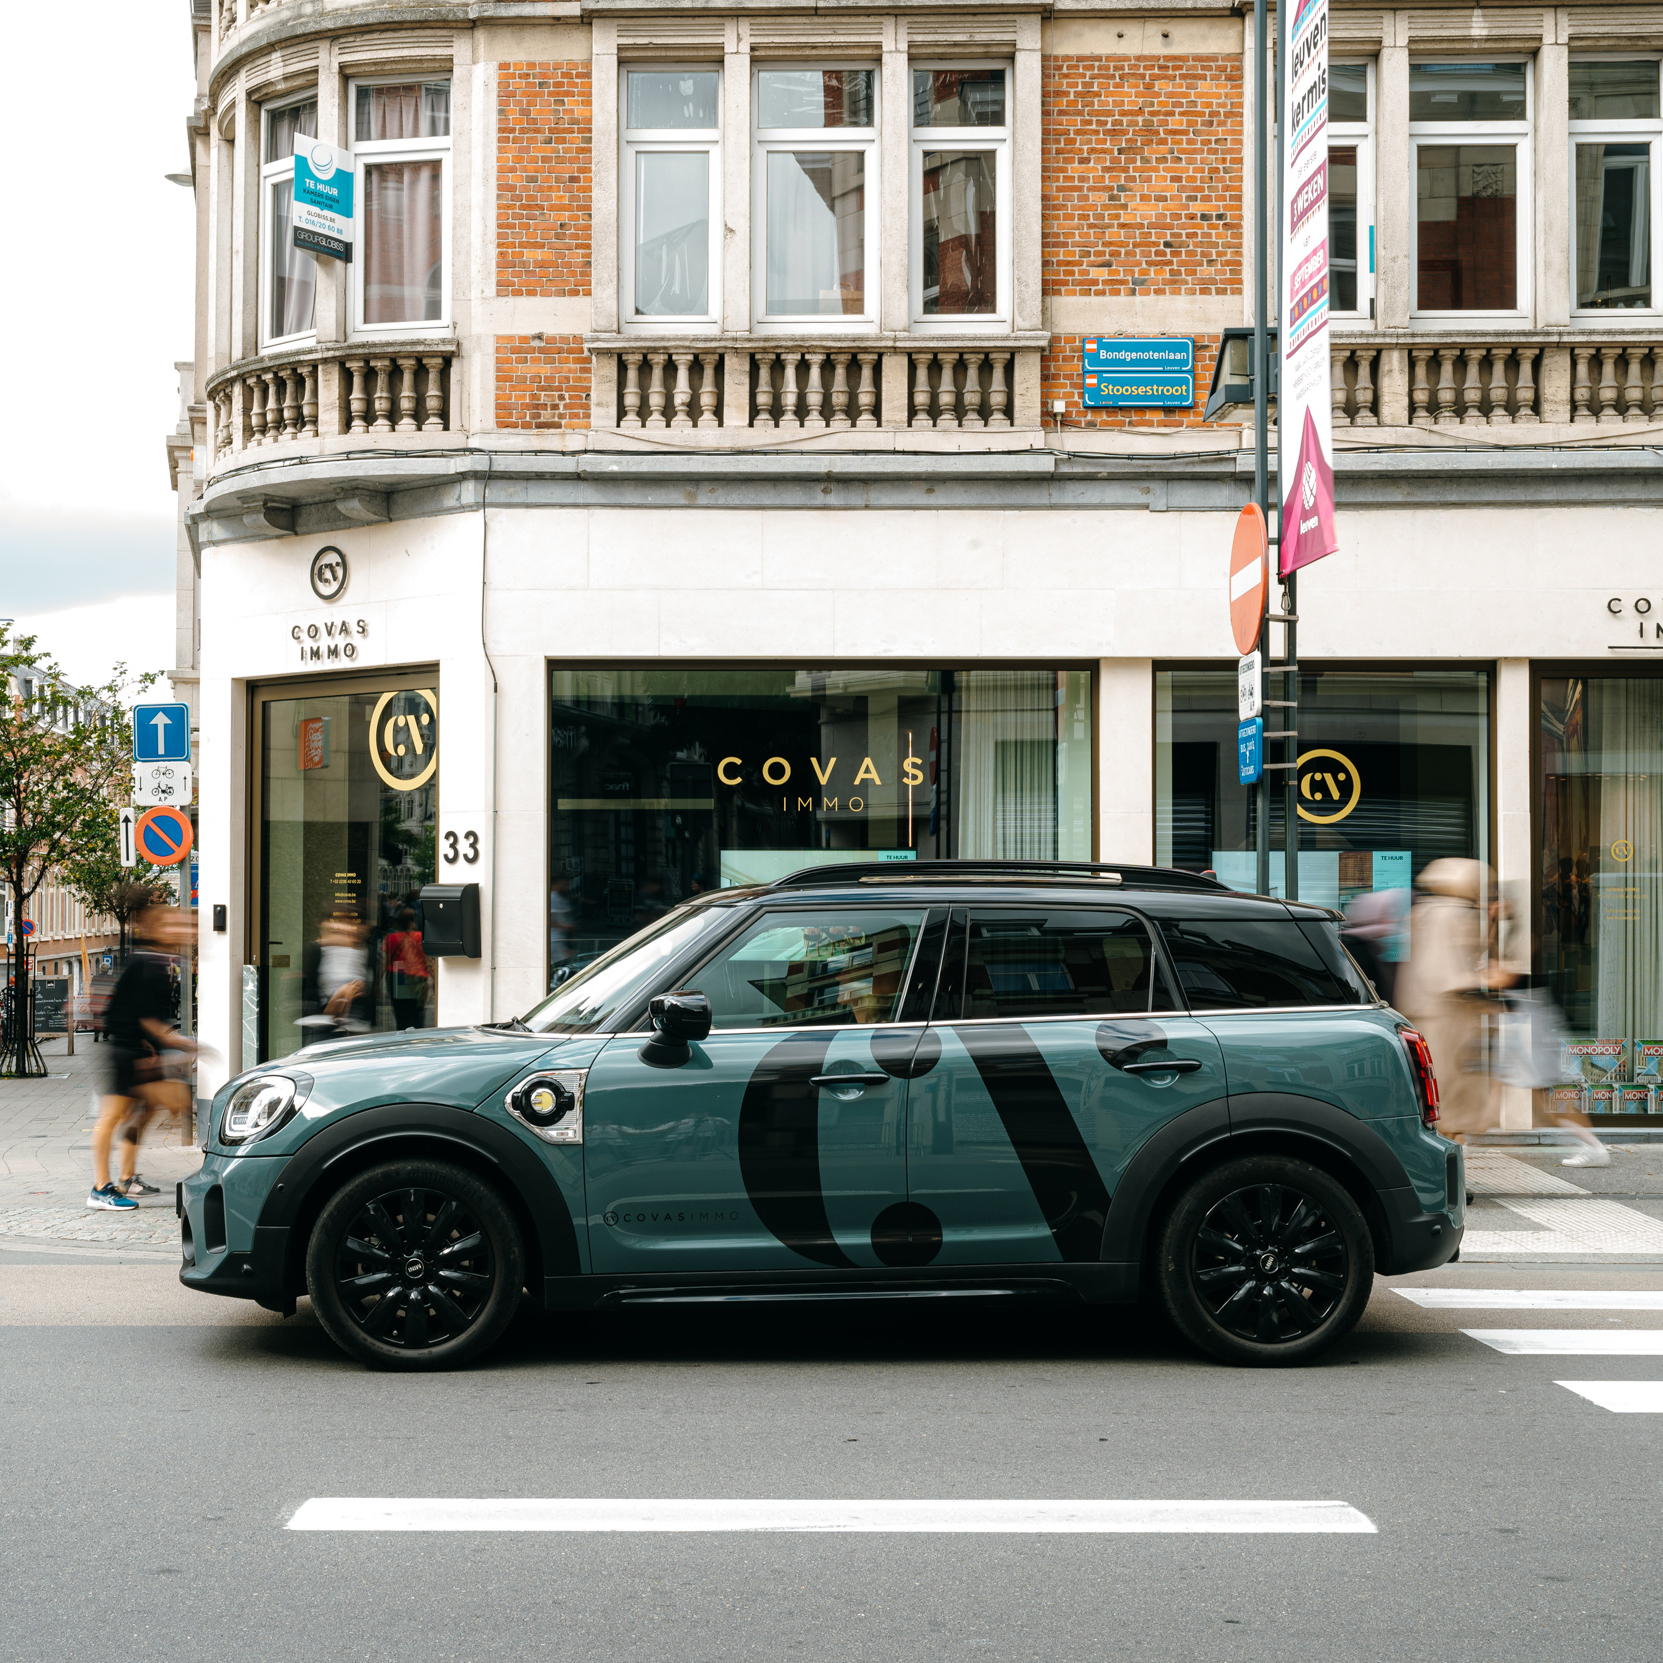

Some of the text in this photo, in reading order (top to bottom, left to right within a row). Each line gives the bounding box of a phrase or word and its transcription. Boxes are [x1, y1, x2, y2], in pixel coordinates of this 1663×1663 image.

[1291, 11, 1327, 85] leuven
[1291, 61, 1327, 138] kermis
[305, 178, 338, 196] TE HUUR
[1297, 170, 1324, 216] WEKEN
[303, 188, 340, 205] KAMERS EIGEN
[309, 197, 334, 210] SANITAIR
[305, 218, 326, 229] 016/20
[328, 224, 335, 232] 60
[307, 210, 335, 223] GLOBISS.BE
[1293, 248, 1325, 292] SEPTEMBER
[1099, 349, 1187, 362] Bondgenotenlaan
[1100, 382, 1188, 396] Stoosestroot
[1300, 515, 1319, 535] leuven
[1607, 597, 1663, 614] CO
[291, 618, 366, 641] COVAS
[300, 642, 356, 662] IMMO
[716, 755, 925, 787] COVAS
[782, 796, 865, 812] IMMO
[443, 830, 479, 864] 33
[1567, 1046, 1621, 1055] MONOPOLY
[1555, 1091, 1580, 1099] MONO
[623, 1210, 739, 1223] COVAS IMMO
